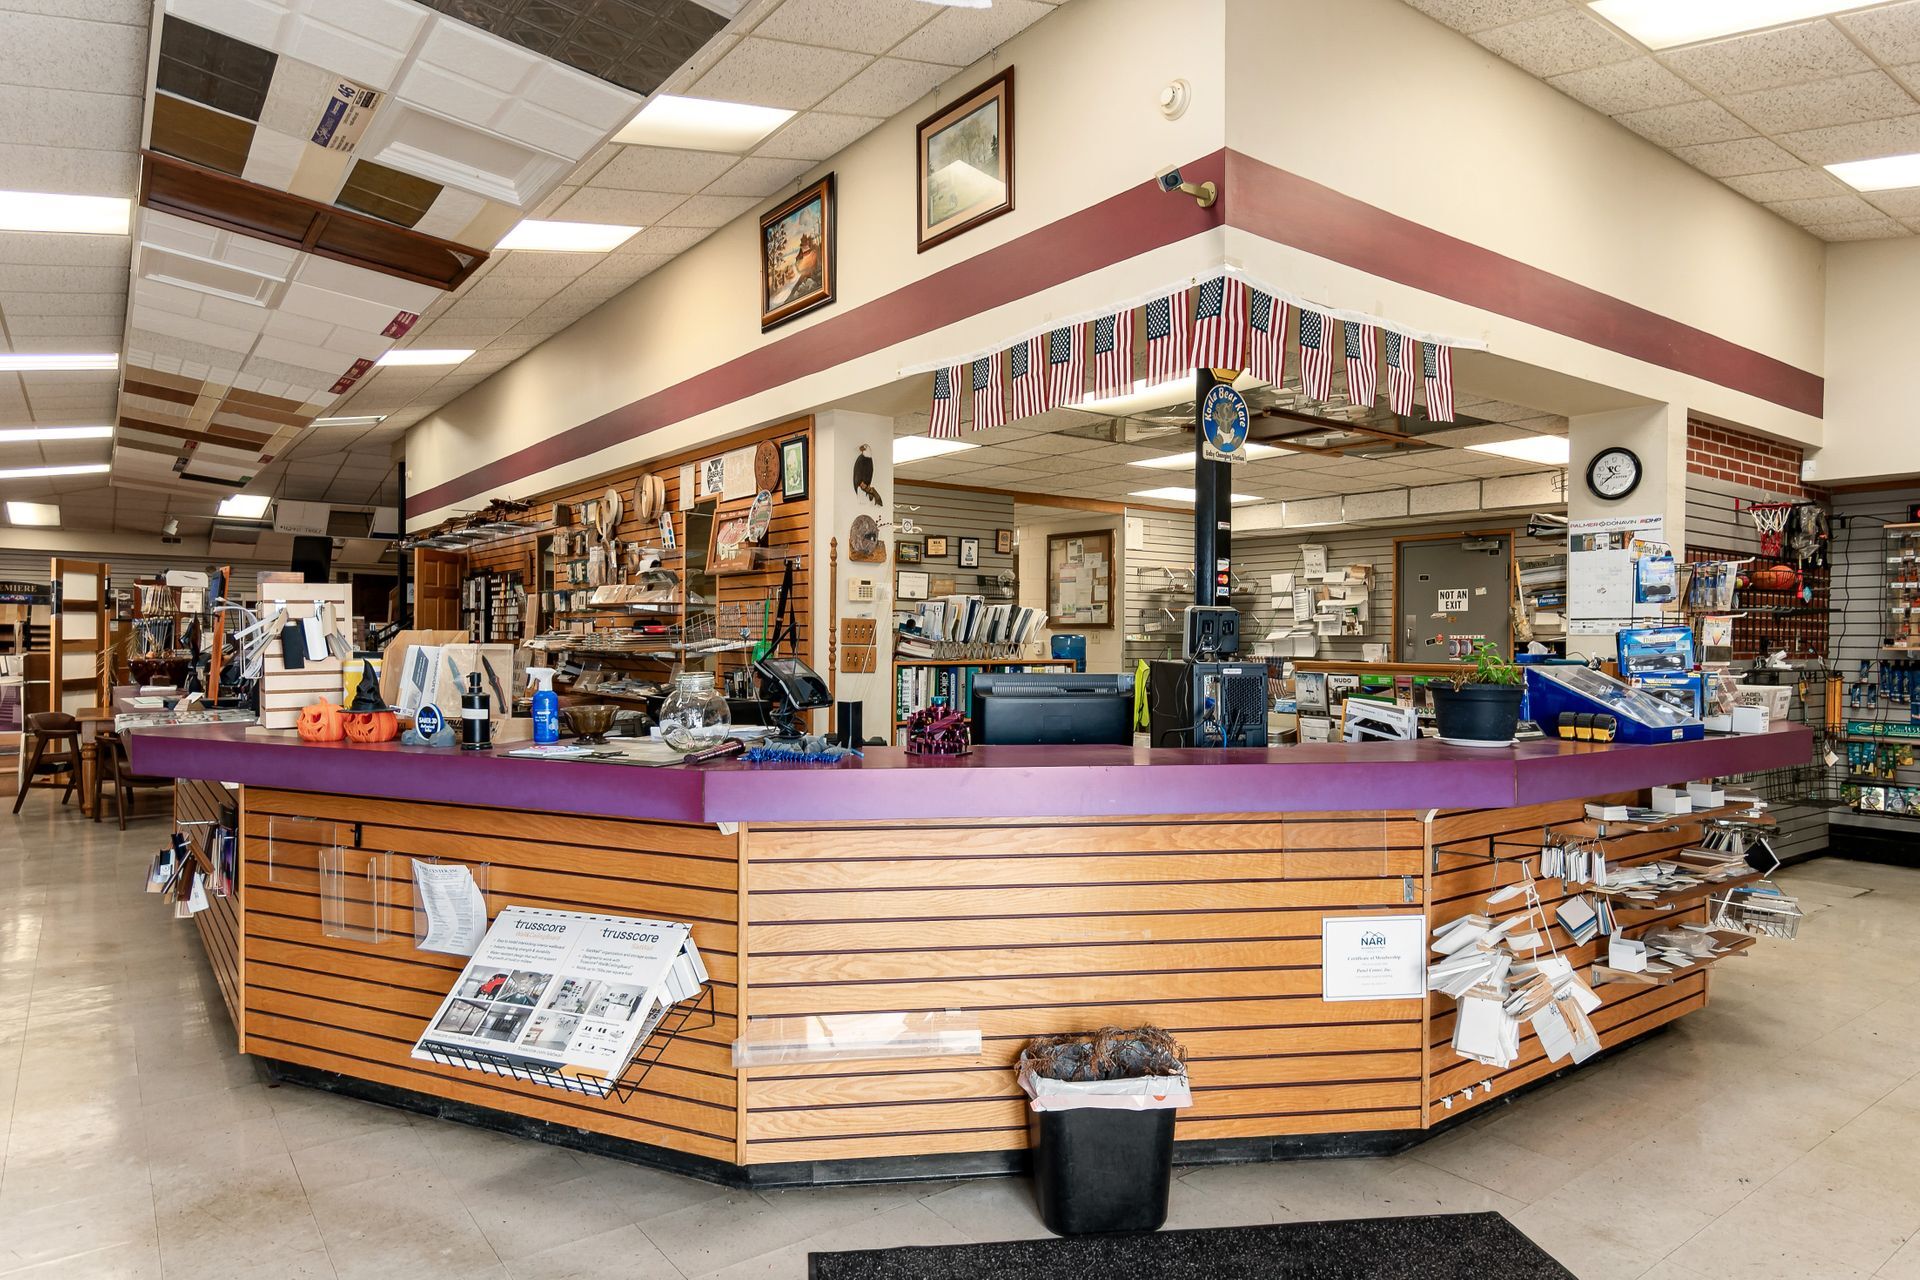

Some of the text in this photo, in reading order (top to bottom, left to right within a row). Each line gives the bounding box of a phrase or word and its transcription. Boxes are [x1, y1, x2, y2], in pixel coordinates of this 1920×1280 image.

[338, 84, 356, 98] 46
[1204, 388, 1246, 428] Koala Bear Kare
[1216, 451, 1232, 461] Changing
[1440, 590, 1467, 600] NOT AN
[1446, 601, 1462, 610] EXIT
[516, 919, 566, 933] trusscore
[602, 928, 660, 943] trusscore
[1361, 937, 1386, 946] NARI
